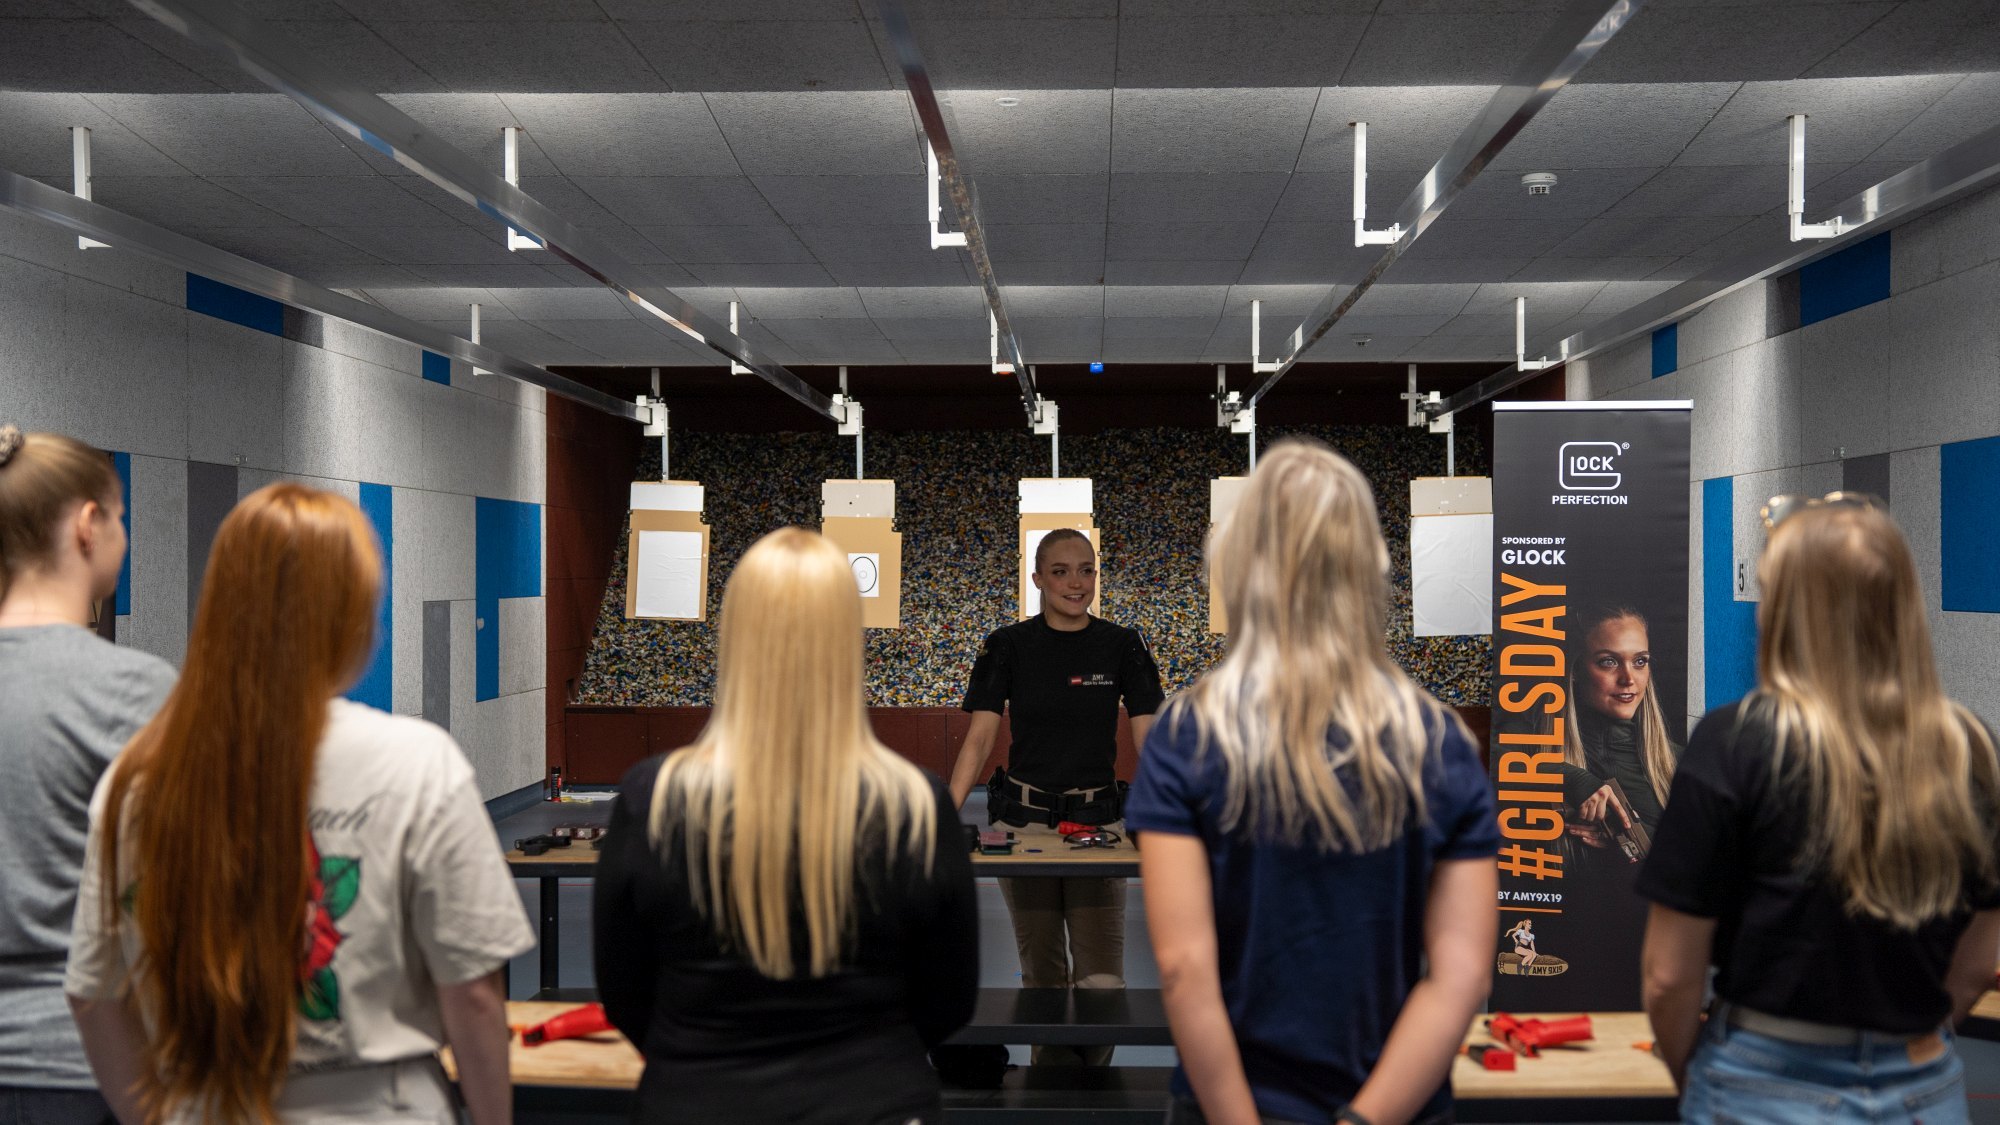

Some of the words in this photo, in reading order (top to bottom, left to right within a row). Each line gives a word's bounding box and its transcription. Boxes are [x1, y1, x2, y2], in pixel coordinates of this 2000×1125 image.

[1552, 495, 1628, 505] PERFECTION
[1502, 537, 1553, 545] SPONSORED
[1555, 537, 1566, 545] BY
[1501, 549, 1566, 565] GLOCK
[1738, 563, 1745, 592] 5
[1497, 572, 1567, 880] #GIRLSDAY
[1497, 891, 1511, 900] BY
[1512, 892, 1563, 903] AMY9X19
[1532, 966, 1548, 975] AMY
[1548, 965, 1563, 975] 9X19
